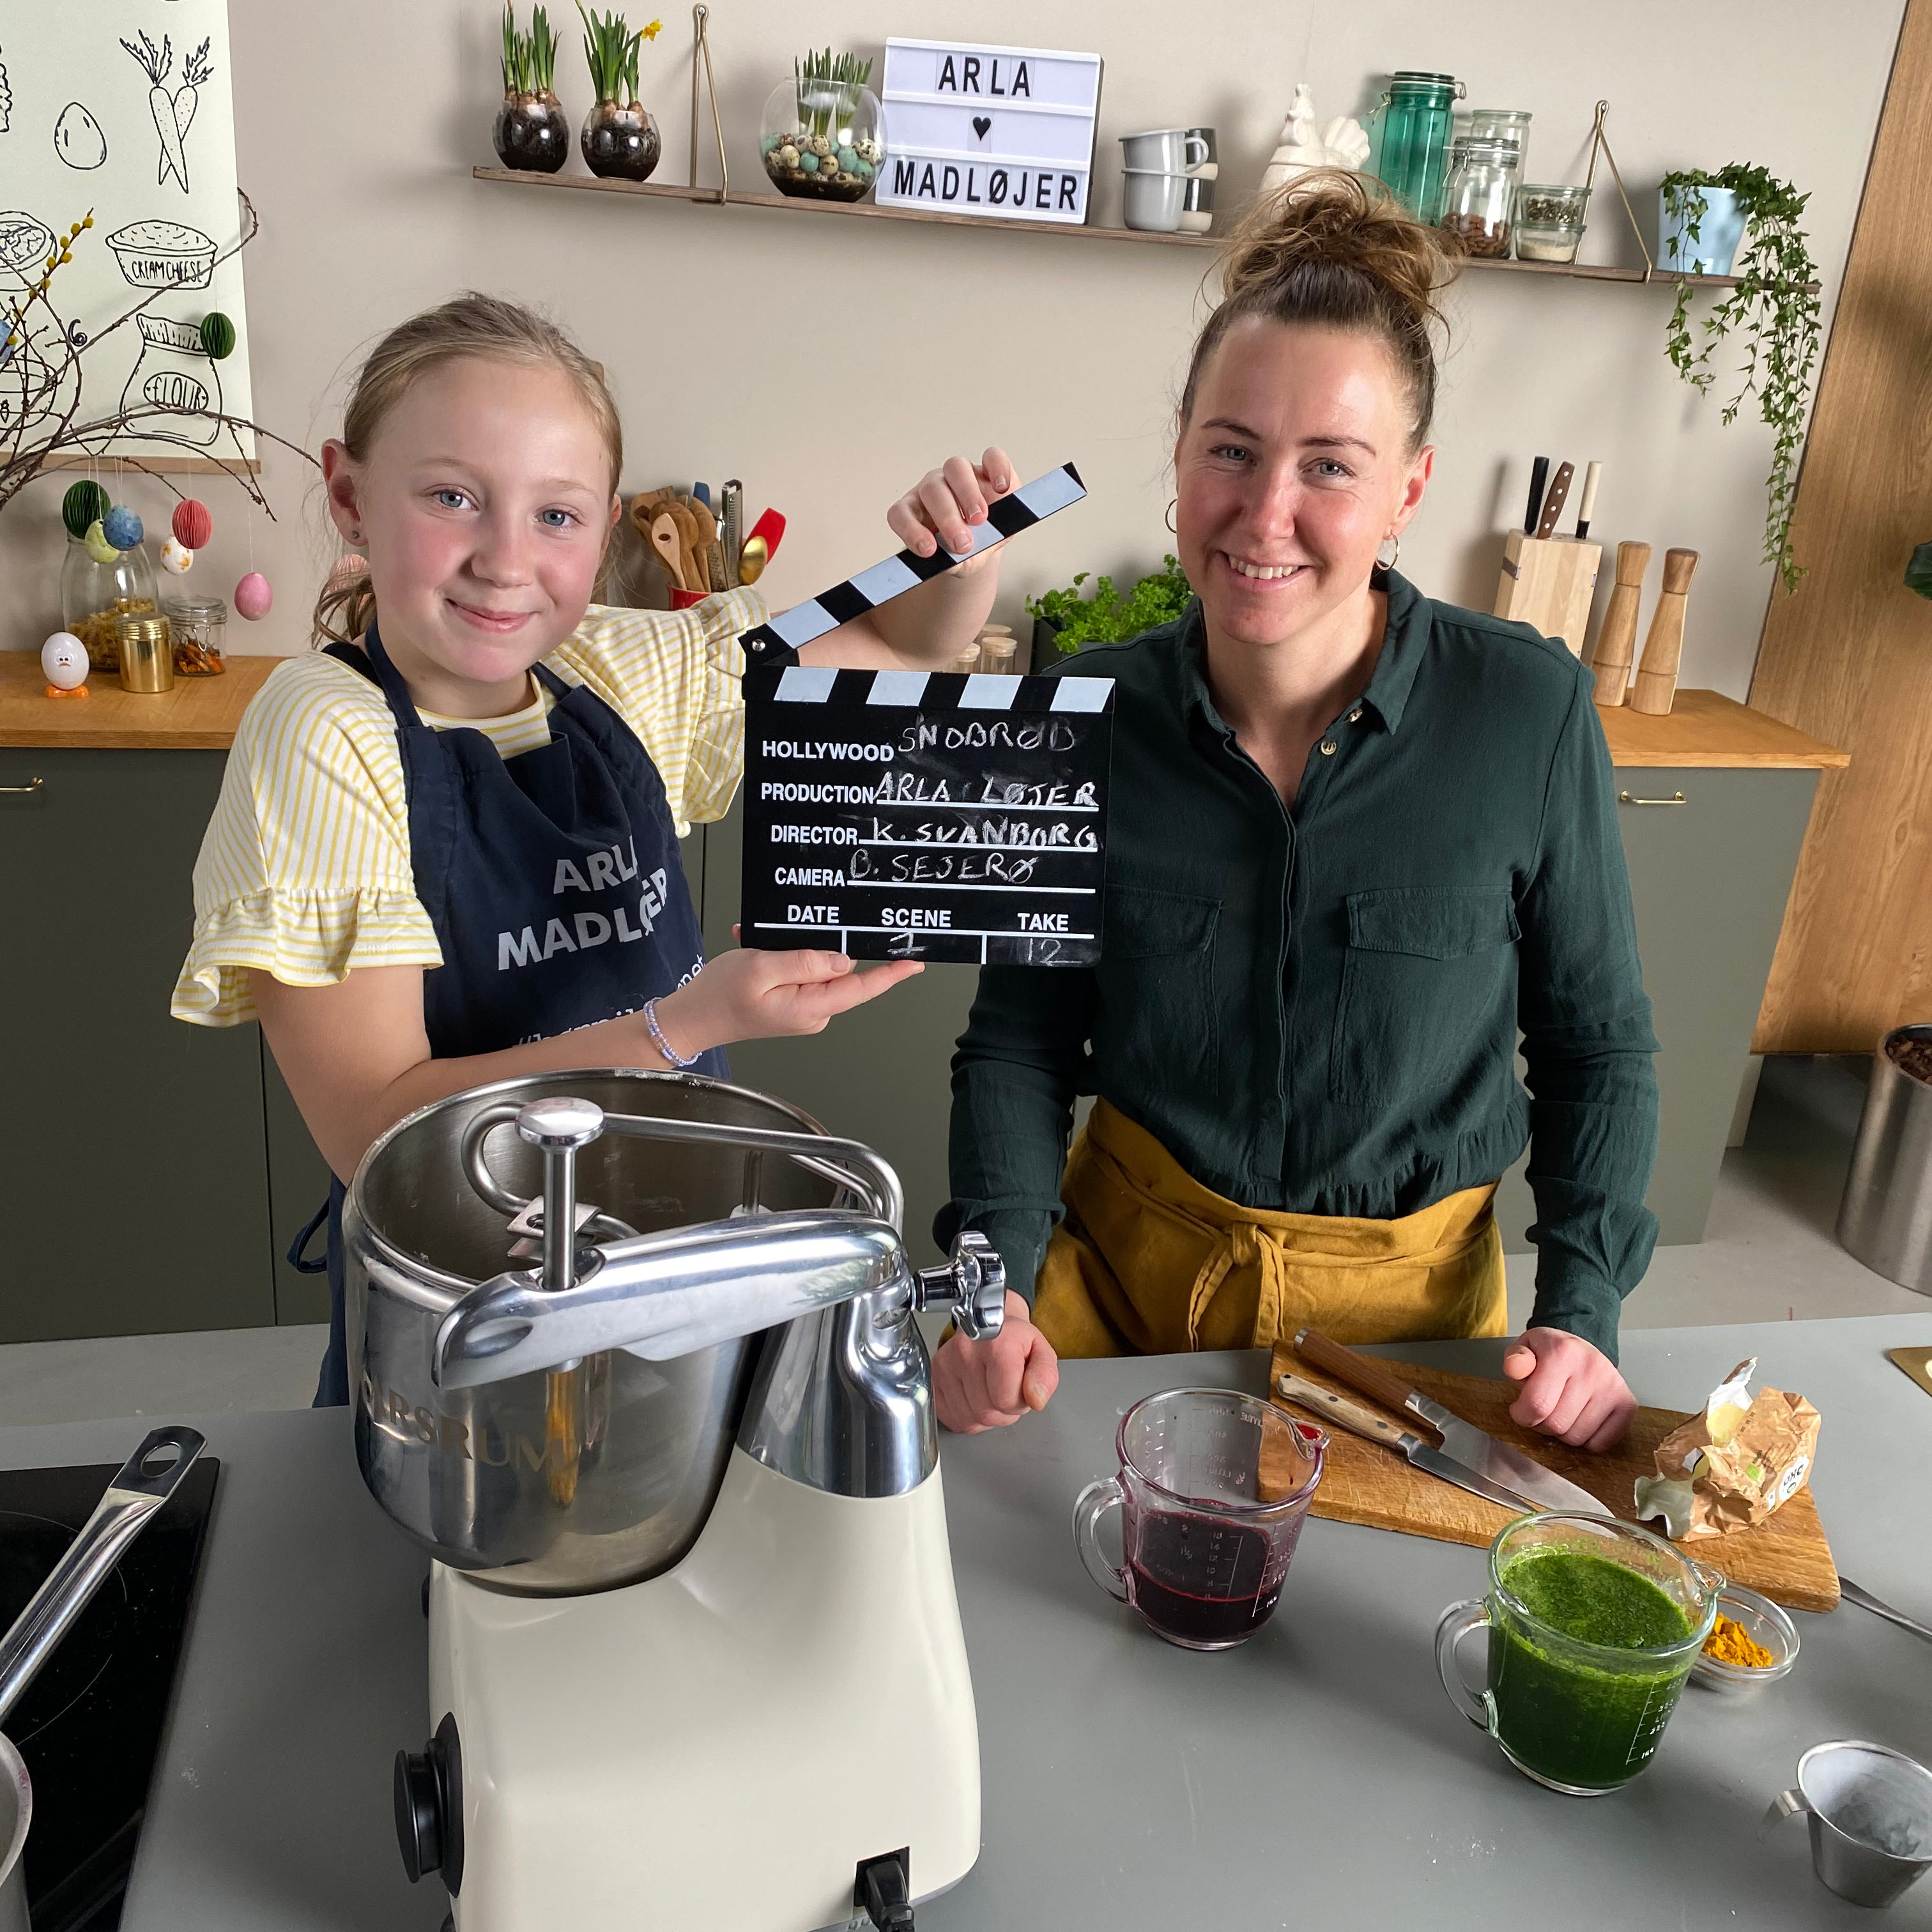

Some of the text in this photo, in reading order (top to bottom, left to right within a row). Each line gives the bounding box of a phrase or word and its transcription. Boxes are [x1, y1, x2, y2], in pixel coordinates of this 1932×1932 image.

[938, 55, 1031, 97] ARLA
[894, 159, 1077, 210] MADLØJER
[762, 740, 894, 762] HOLLYWOOD
[761, 783, 875, 805] PRODUCTION
[873, 770, 951, 803] ARLA
[770, 825, 858, 845] DIRECTOR
[774, 868, 846, 887] CAMERA
[787, 905, 1069, 931] DATE SCENE TAKE
